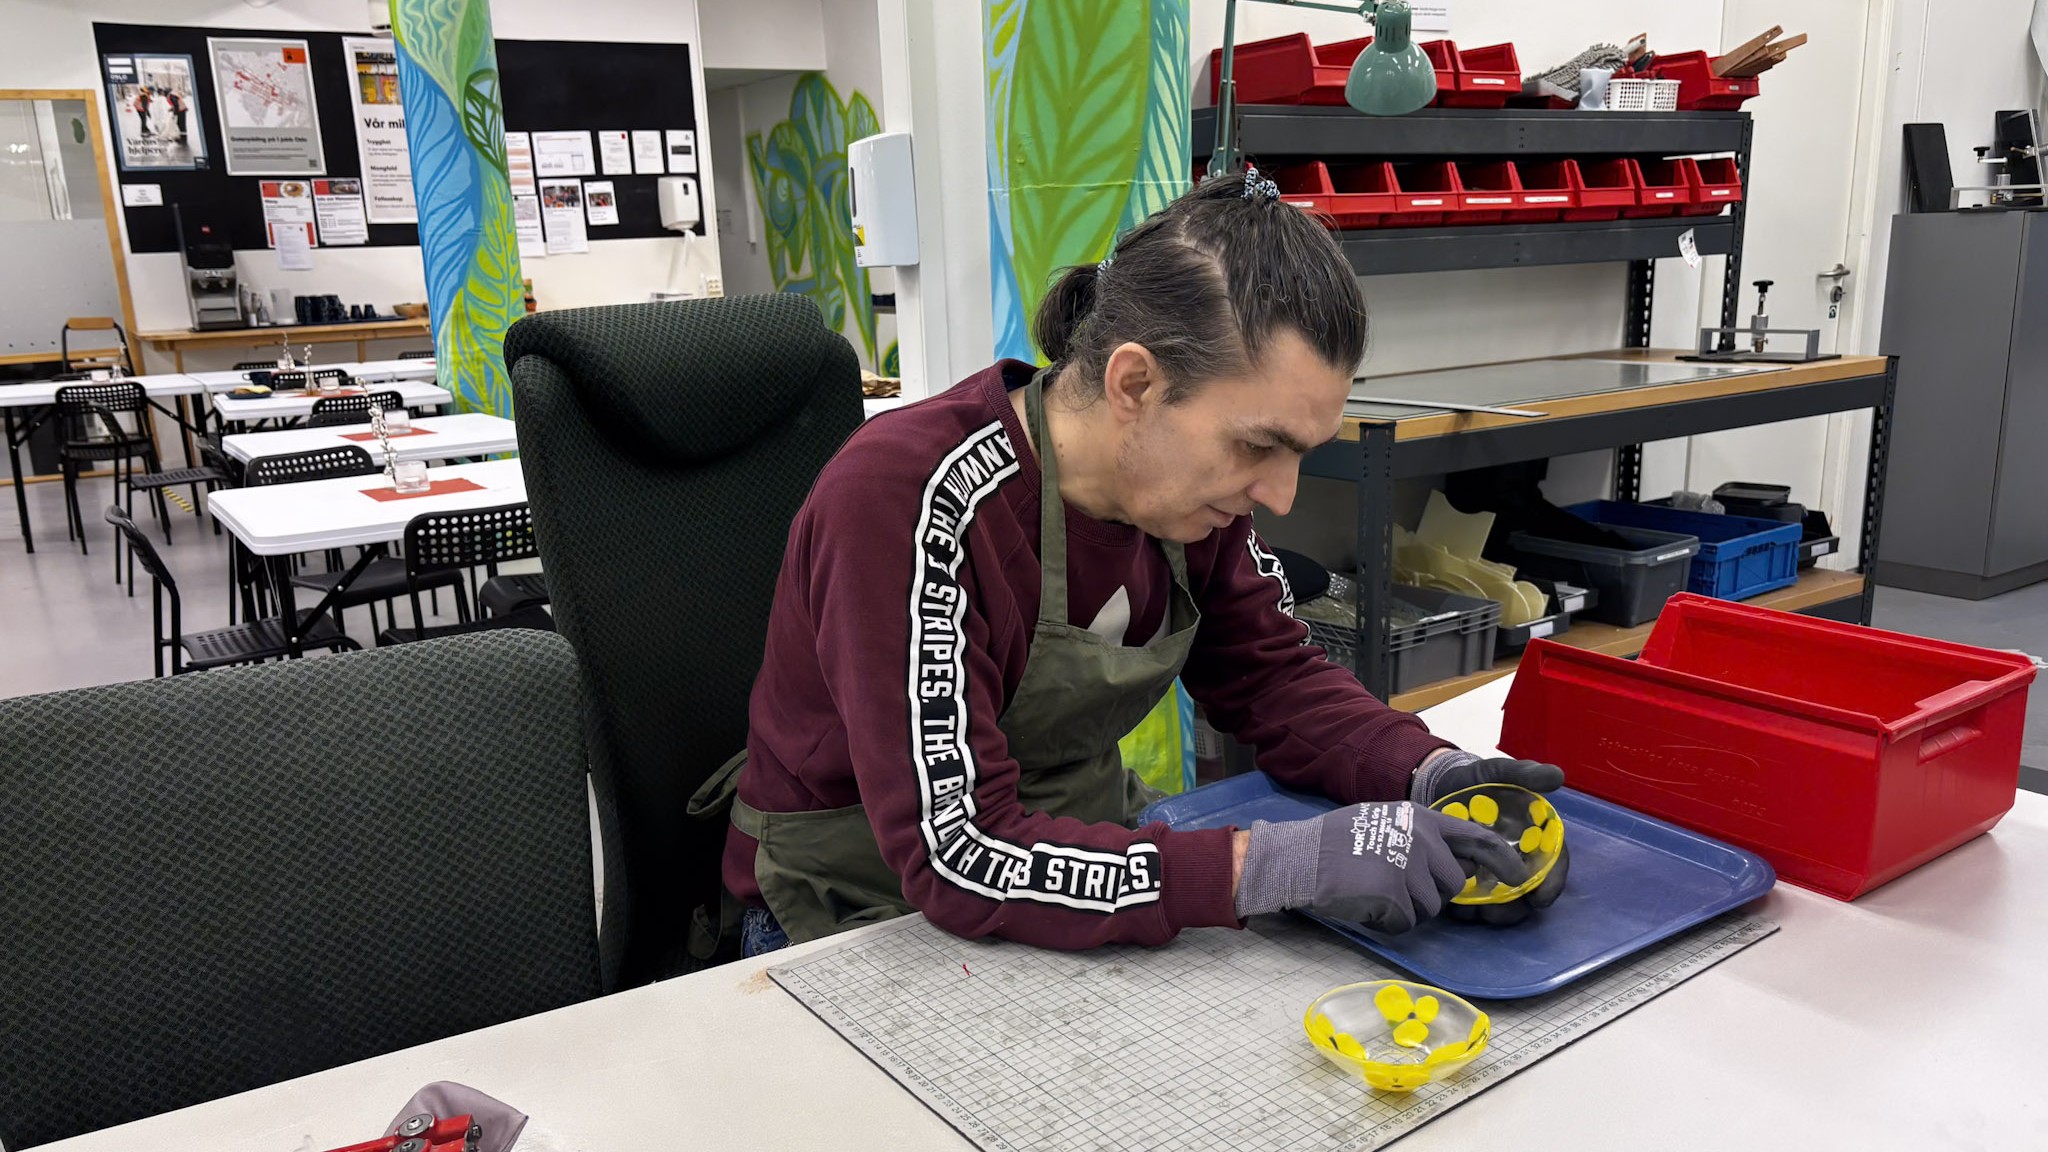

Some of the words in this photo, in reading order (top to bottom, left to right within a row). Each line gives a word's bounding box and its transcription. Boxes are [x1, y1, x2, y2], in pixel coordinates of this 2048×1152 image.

[364, 118, 384, 129] Vår
[389, 118, 406, 129] mil
[924, 715, 960, 766] THE
[1366, 827, 1378, 850] Touch
[1368, 1130, 1379, 1138] 17
